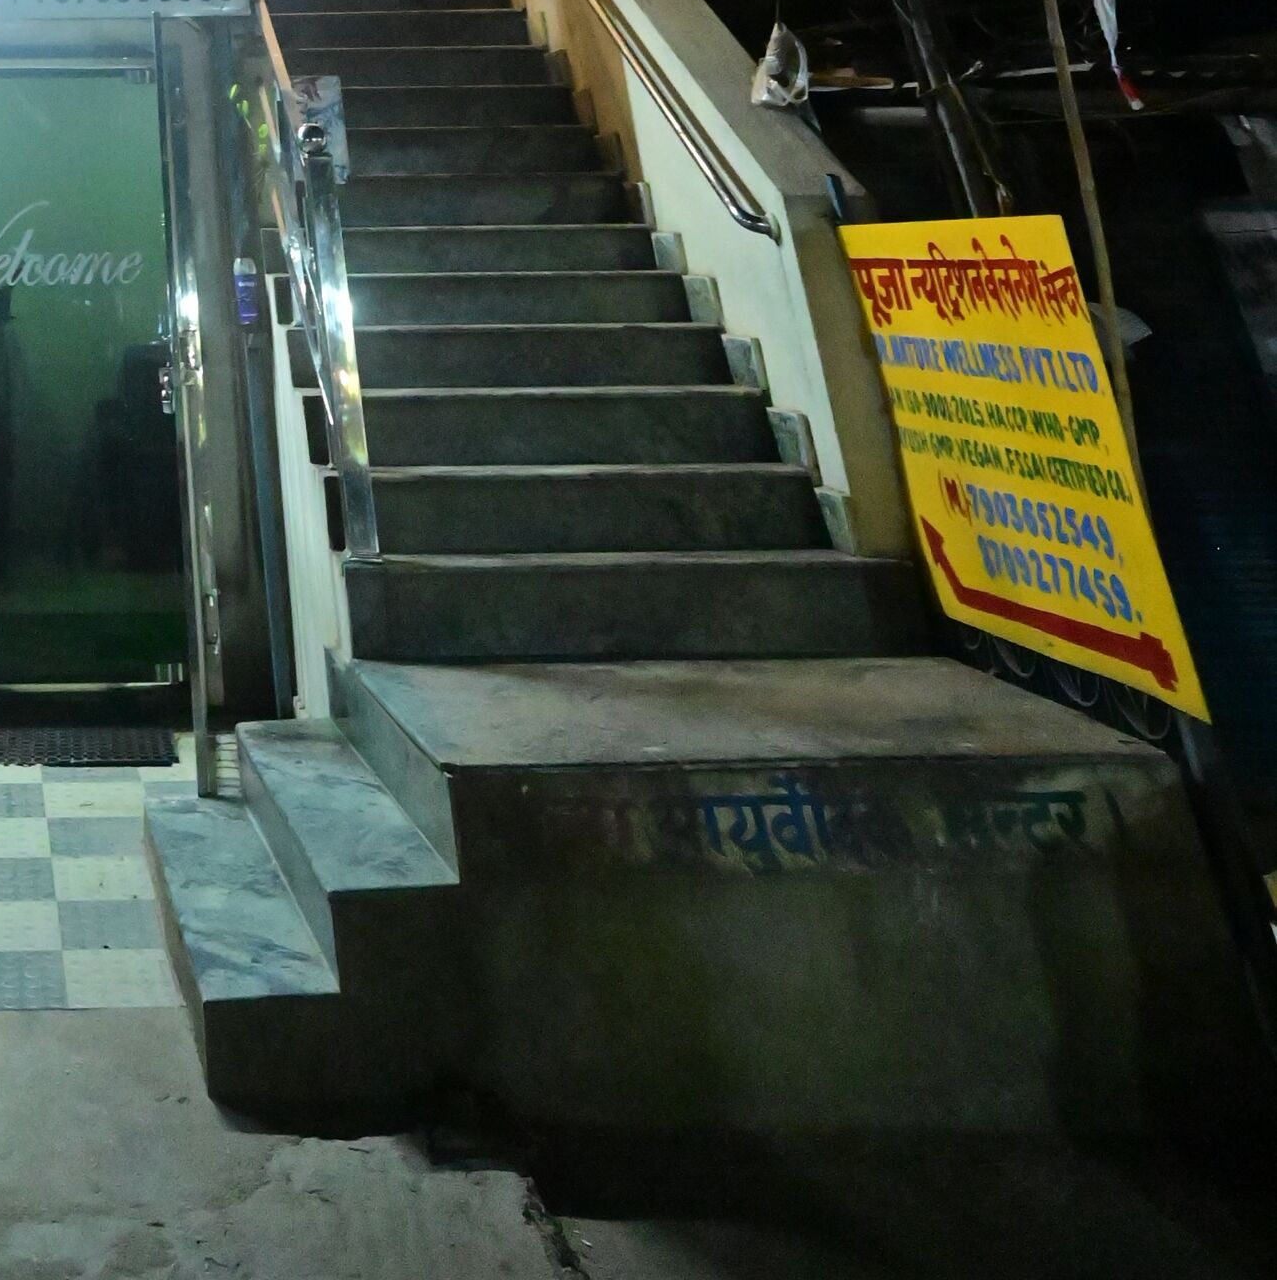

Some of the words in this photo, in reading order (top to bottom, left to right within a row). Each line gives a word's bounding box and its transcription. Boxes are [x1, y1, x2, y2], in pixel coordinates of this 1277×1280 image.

[849, 256, 914, 328] पूजा
[939, 339, 1023, 384] WELLNESS
[1046, 455, 1109, 501] CERTIFIED
